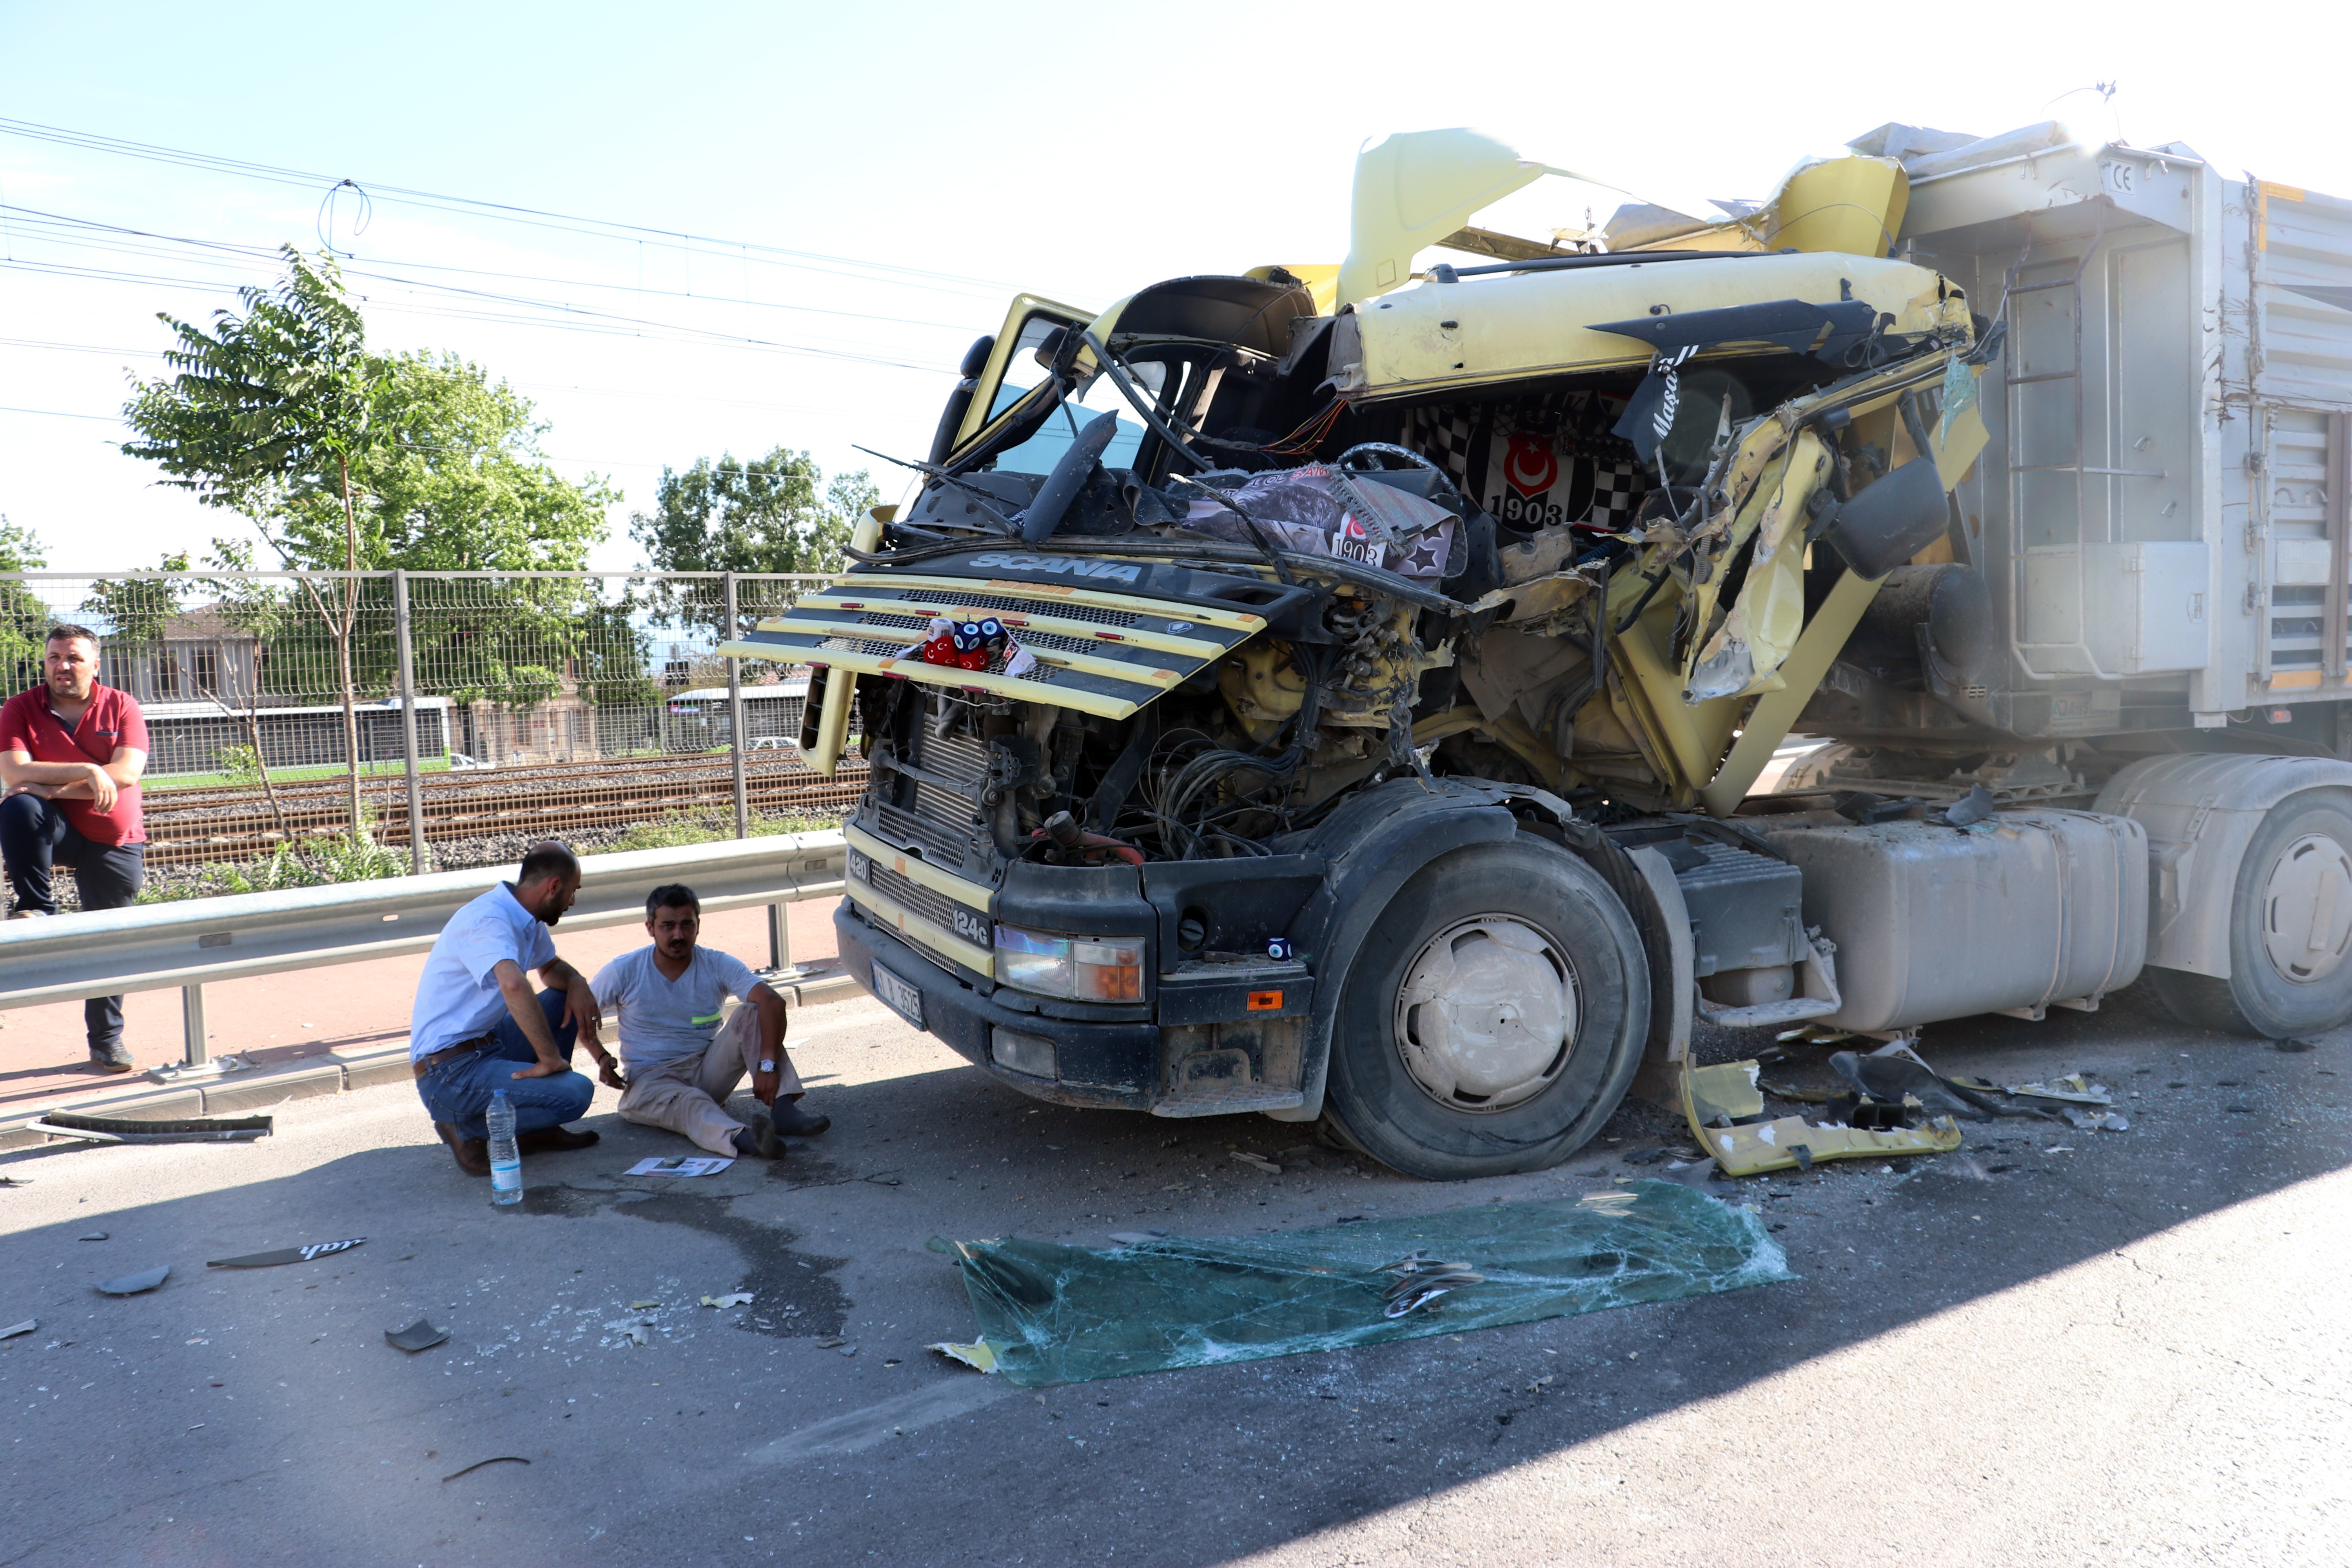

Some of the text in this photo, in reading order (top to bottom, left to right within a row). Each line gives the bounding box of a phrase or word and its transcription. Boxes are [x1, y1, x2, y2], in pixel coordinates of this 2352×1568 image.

[2114, 164, 2131, 191] CE
[1491, 494, 1563, 526] 1903
[1334, 537, 1377, 566] 1903
[969, 553, 1142, 582] SCANIA
[849, 854, 867, 881] 420
[953, 909, 988, 946] 124G
[887, 976, 895, 1002] B
[898, 984, 920, 1019] 3525
